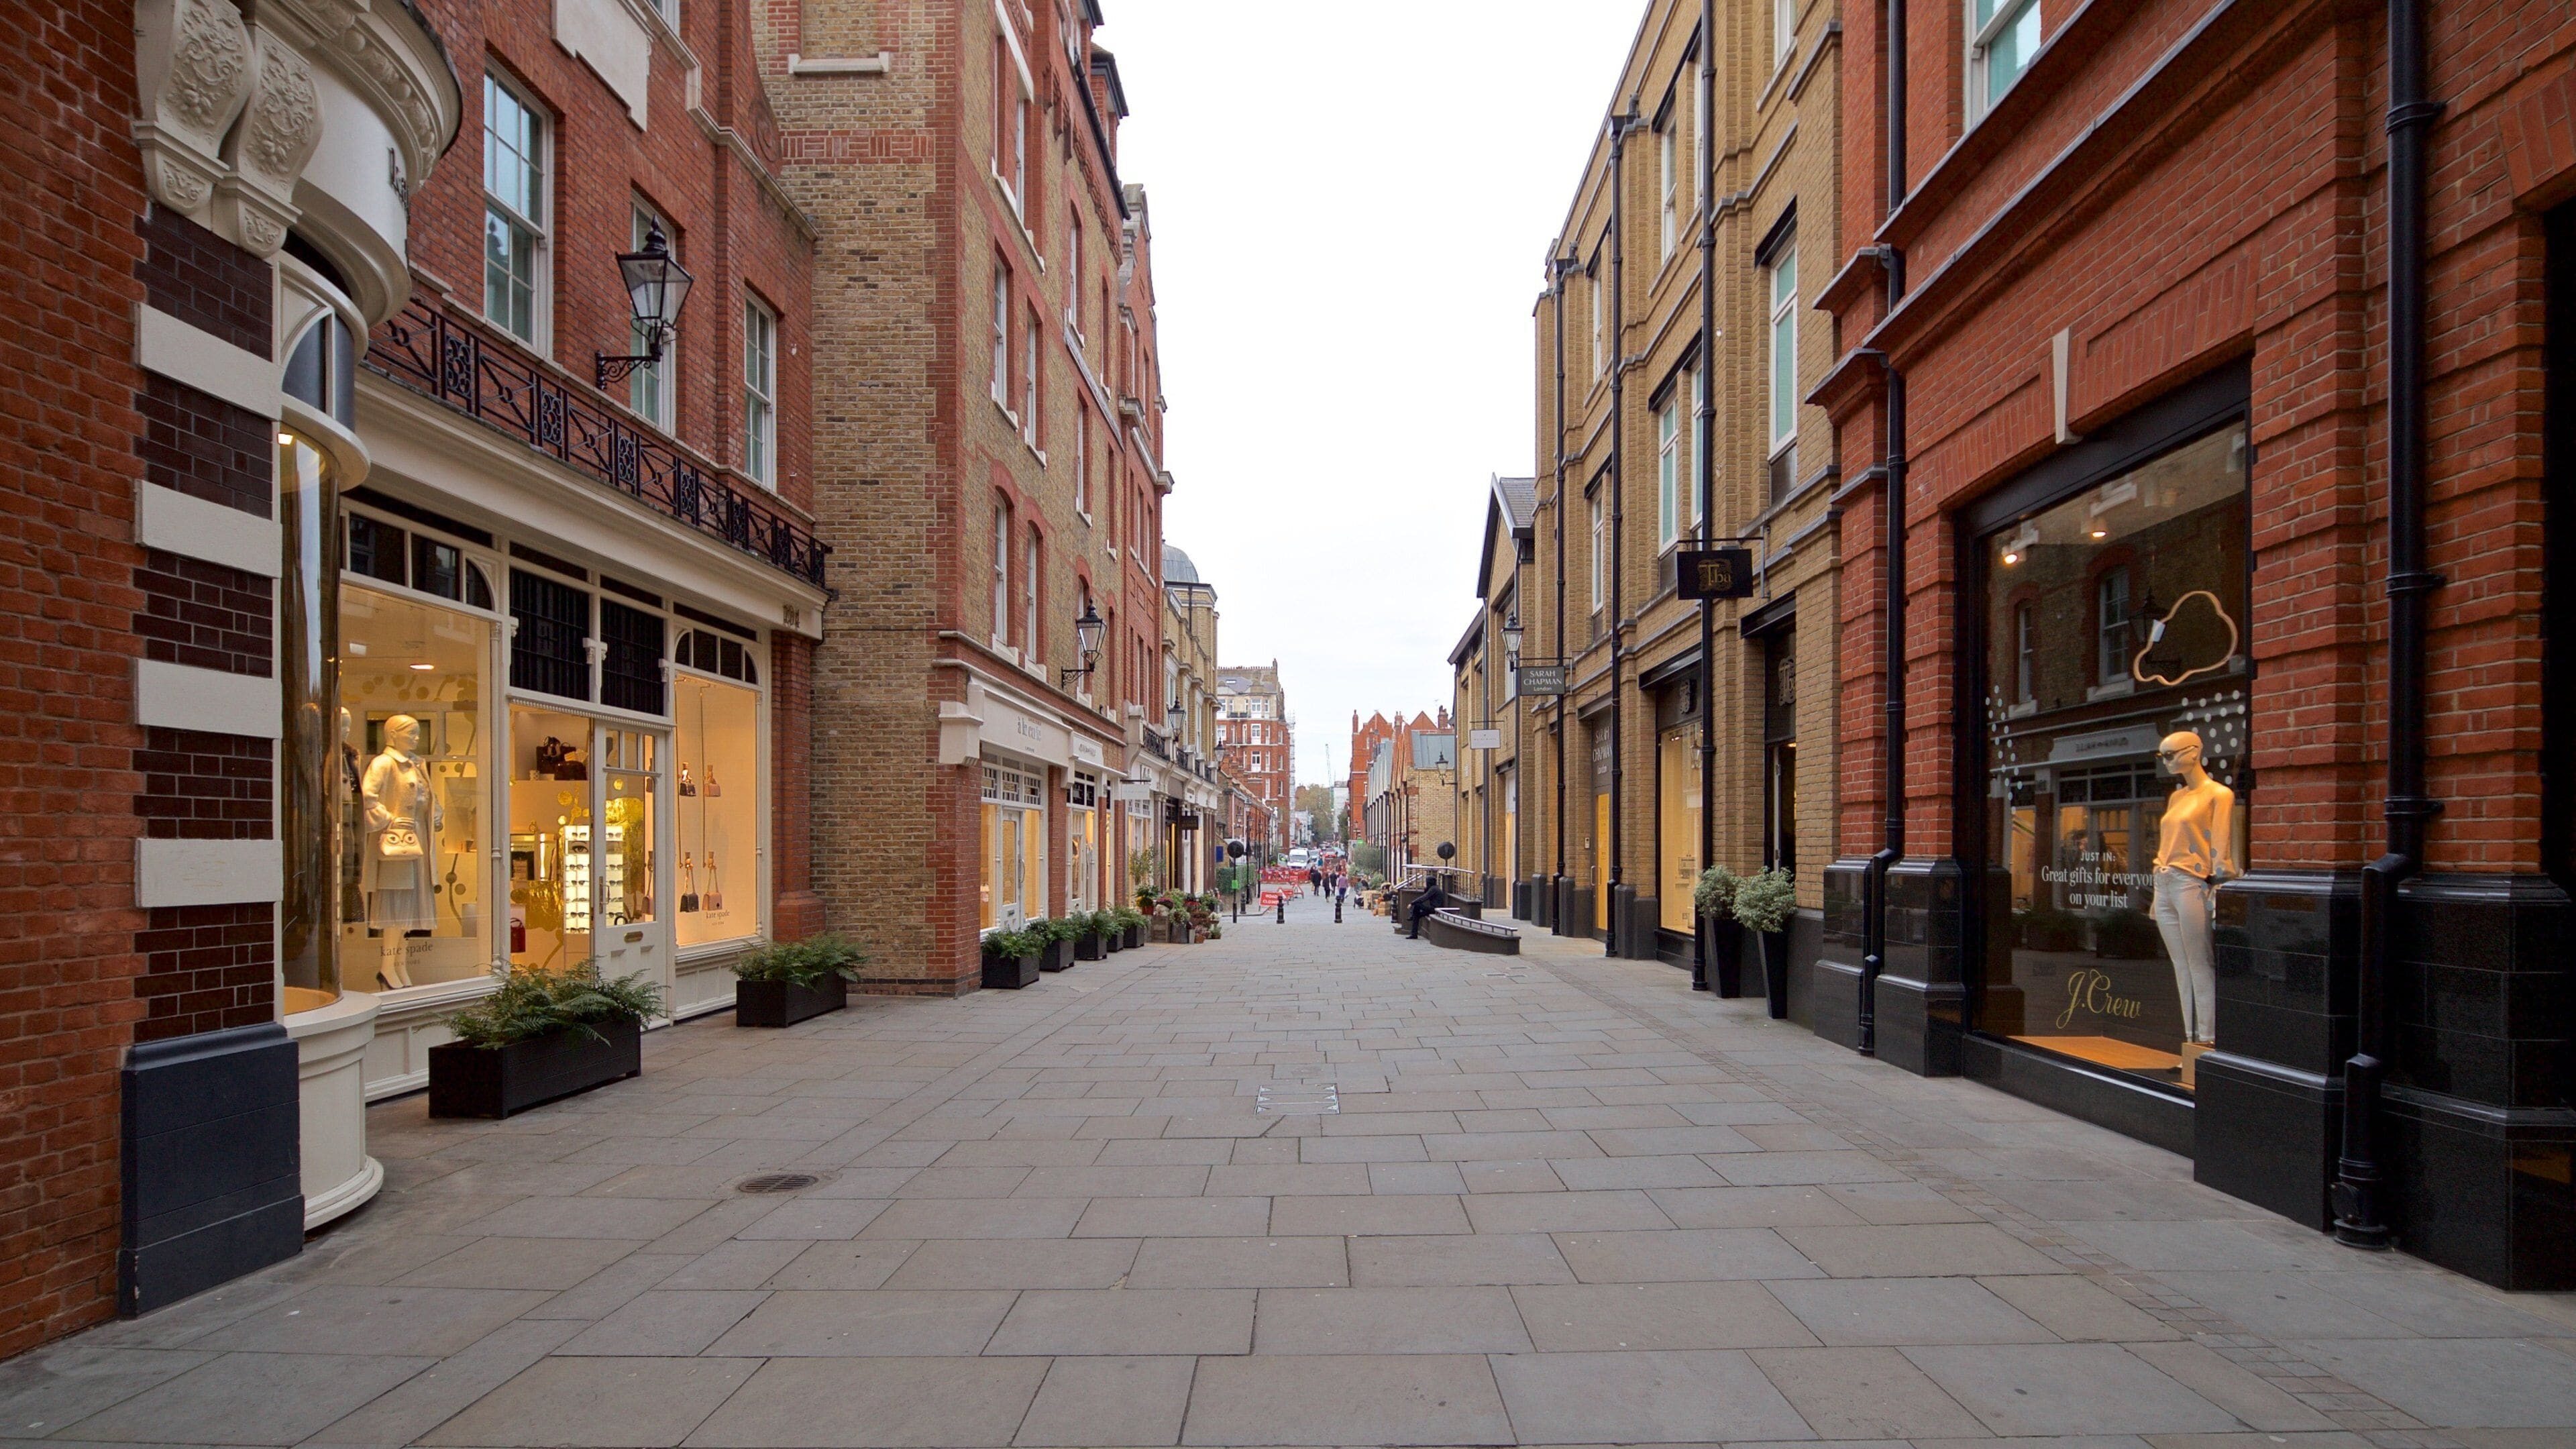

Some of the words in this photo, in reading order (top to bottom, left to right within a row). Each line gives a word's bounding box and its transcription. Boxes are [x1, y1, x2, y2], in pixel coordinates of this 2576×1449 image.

[2080, 852, 2100, 861] JUST
[2102, 852, 2116, 861] IN:
[2041, 865, 2068, 883] Great
[2070, 867, 2093, 887] gifts
[2095, 867, 2110, 884] for
[2112, 873, 2154, 890] everyon
[2069, 893, 2082, 905] on
[2084, 894, 2108, 909] your
[2110, 890, 2129, 908] list
[380, 945, 402, 957] kate
[405, 941, 433, 957] spade
[2056, 969, 2141, 1028] J.Crew
